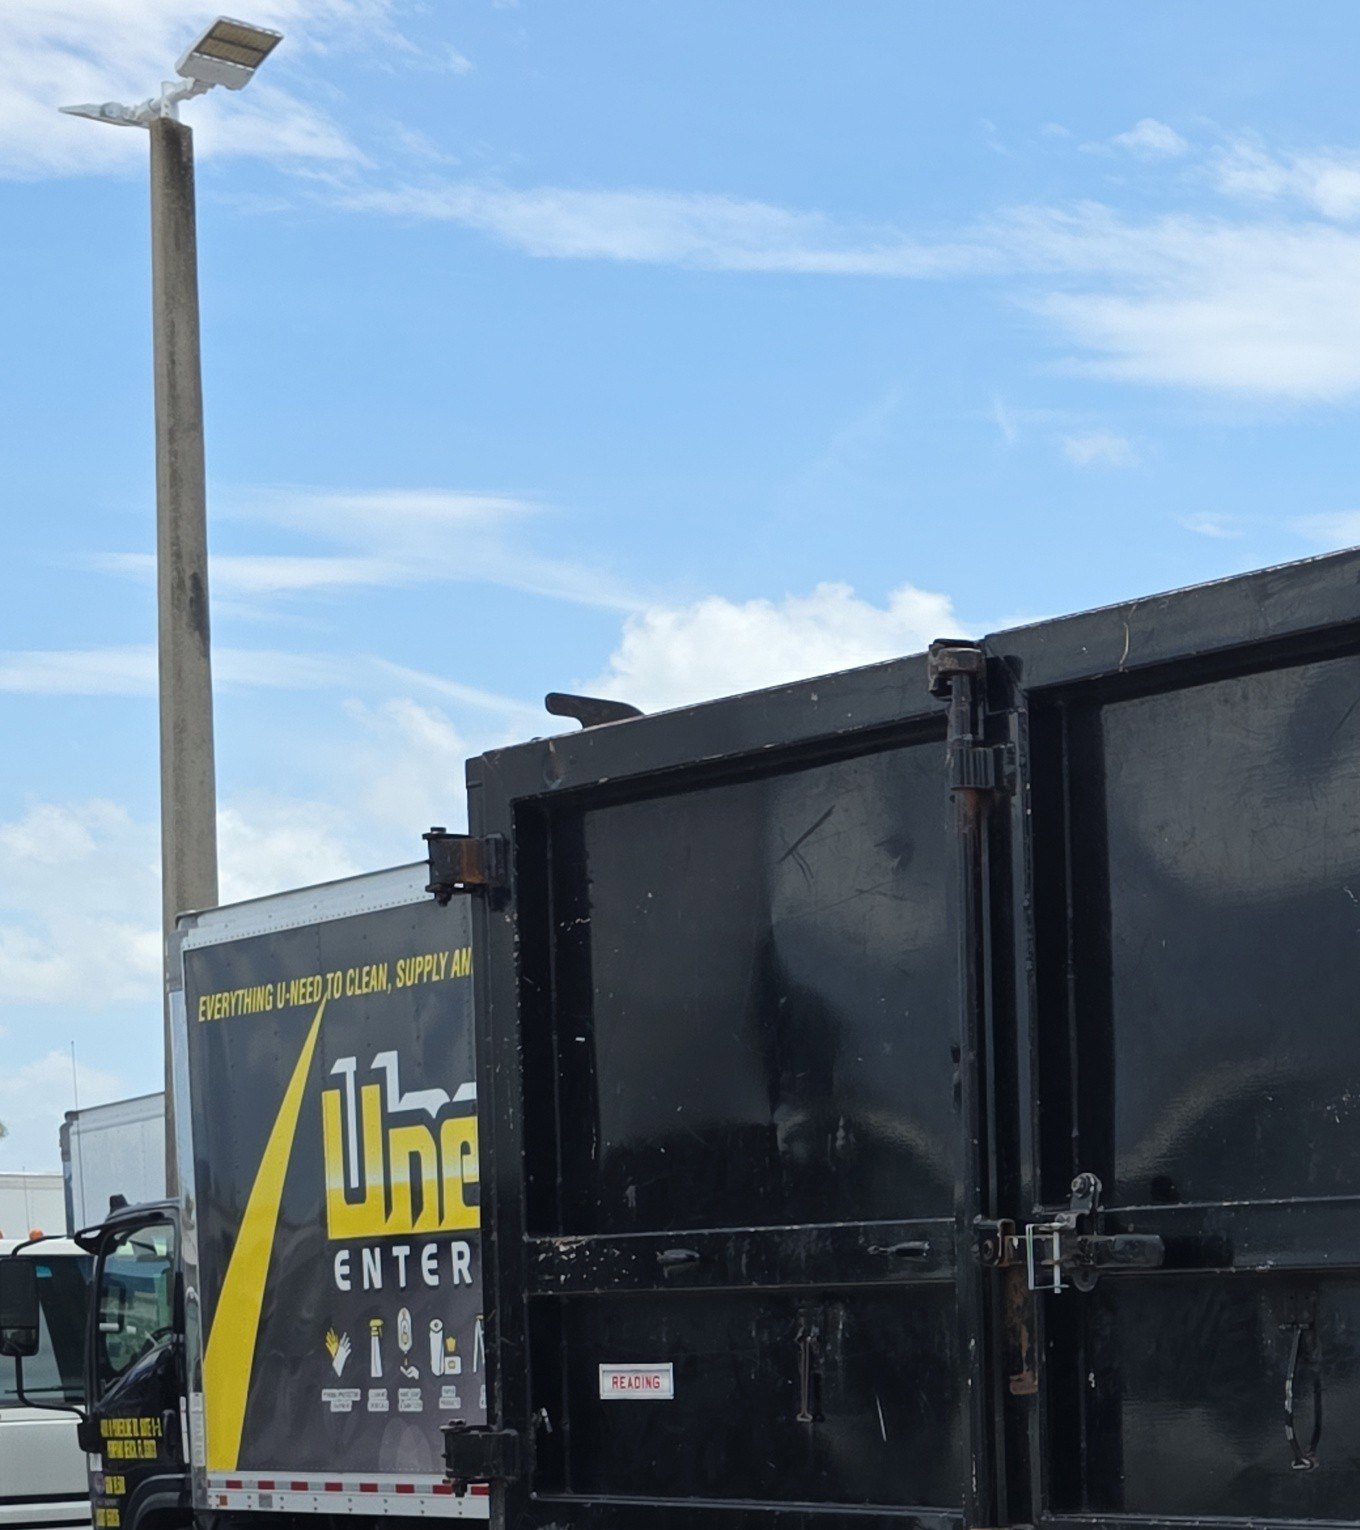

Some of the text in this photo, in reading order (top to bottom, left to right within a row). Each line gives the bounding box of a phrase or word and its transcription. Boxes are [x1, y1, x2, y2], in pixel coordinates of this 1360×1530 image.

[198, 946, 473, 1023] EVERYTHING U-NEED TO CLEAN, SUPPLY AN
[334, 1241, 473, 1292] ENTER
[611, 1375, 661, 1389] READING
